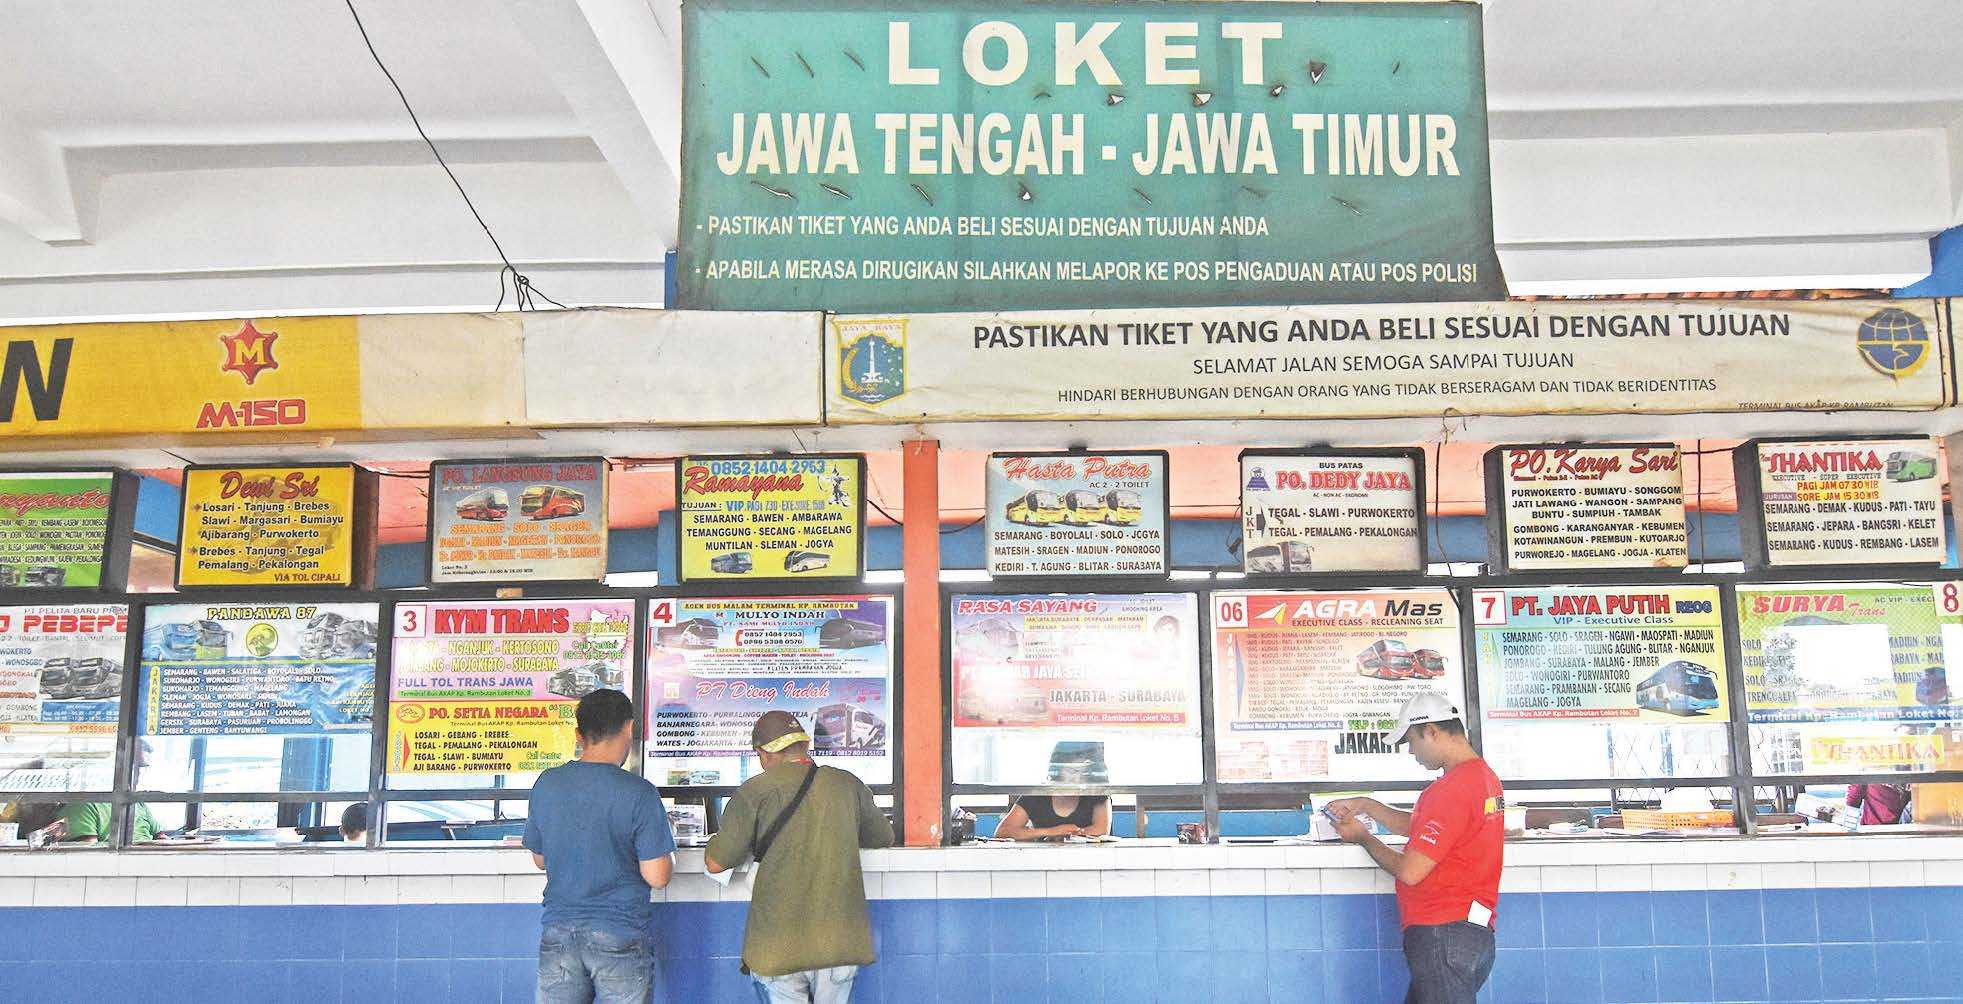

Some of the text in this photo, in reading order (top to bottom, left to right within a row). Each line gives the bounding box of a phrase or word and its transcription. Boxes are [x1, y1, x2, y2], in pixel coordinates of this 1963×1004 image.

[888, 21, 1283, 86] LOKET
[716, 112, 1461, 177] JAWA TENGAH JAWA TIMUR
[708, 216, 1269, 237] PASTIKAN TIKET YANG ANDA BELI SESUAI DENGAN TUJUAN ANDA
[706, 260, 1477, 285] APABILA MERASA DIRUGIKAN SILAHKAN MELAPOR KE POS PENGADUAN ATAU POS POLISI
[974, 314, 1790, 349] PASTIKAN TIKET YANG ANDA BELI SESUAI DENGAN TUJUAN
[1193, 352, 1574, 375] SELAMAT JALAN SEMOGA SAMPAI TUJUAN
[1058, 379, 1717, 403] HINDARI BERHUBUNGAN DENGAN ORANG YANG TIDAK BERSERAGAM DAN TIDAK BERIDENTITAS
[196, 399, 306, 429] M-150
[1003, 456, 1152, 480] Hasta Putra
[1338, 461, 1363, 469] PATAS
[1767, 450, 1884, 474] SHANTIKA
[220, 471, 320, 500] Dewi Sri
[682, 466, 804, 500] Ramayana
[1275, 470, 1413, 490] PO. DEDY JAYA
[1512, 486, 1682, 497] PURWOKERTO BUMIAYU SONGGOM
[203, 502, 330, 512] Losari Tanjung Brebes
[1268, 507, 1415, 518] TEGAL SLAWI PURWOKERTO
[1765, 501, 1936, 514] SEMARANG DEMAK KUDUS PATI TAYU
[202, 515, 344, 526] Slawi Margasari Bumiayu
[693, 512, 842, 523] SEMARANG BAWEN AMBARAWA
[200, 530, 319, 540] Ajibarang Purwokerto
[687, 525, 852, 537] TEMANGGUNG SECANG MAGELANG
[995, 531, 1043, 541] SEMARANG
[1050, 530, 1093, 540] BOYOLALI
[1100, 530, 1124, 539] SOLO
[1268, 527, 1418, 537] TEGAL PEMALANG PEKALONGAN
[199, 545, 325, 556] Brebes Tanjung Tegal
[706, 539, 834, 551] MUNTILAN SLEMAN JOGYA
[995, 545, 1161, 556] MATESIH SRAGEN MADIUN PONOROGO
[198, 560, 319, 571] Pemalang Pekalongan
[958, 600, 1098, 614] RASA SAYANG
[1511, 596, 1543, 616] PT.
[1548, 595, 1603, 615] JAYA
[1605, 594, 1670, 614] PUTIH
[1752, 595, 1844, 613] SURYA
[1943, 583, 1959, 613] 8
[207, 607, 317, 620] PANDAWA 87
[653, 602, 673, 624] 4
[735, 611, 825, 619] MULYO INDAH
[1221, 602, 1242, 622] 06
[1292, 599, 1442, 619] AGRA Mas
[1481, 597, 1496, 620] 7
[403, 610, 417, 632] 3
[434, 608, 570, 634] KYM TRANS
[1292, 617, 1444, 627] EXECUTIVE CLASS RECLEANING SEAT
[398, 677, 534, 687] FULL TOL TRANS JAWA
[696, 680, 833, 704] PT Dieng Indah
[428, 706, 549, 719] PO. SETIA NEGARA
[415, 741, 538, 749] TEGAL PEMALANG PEKALONGAN
